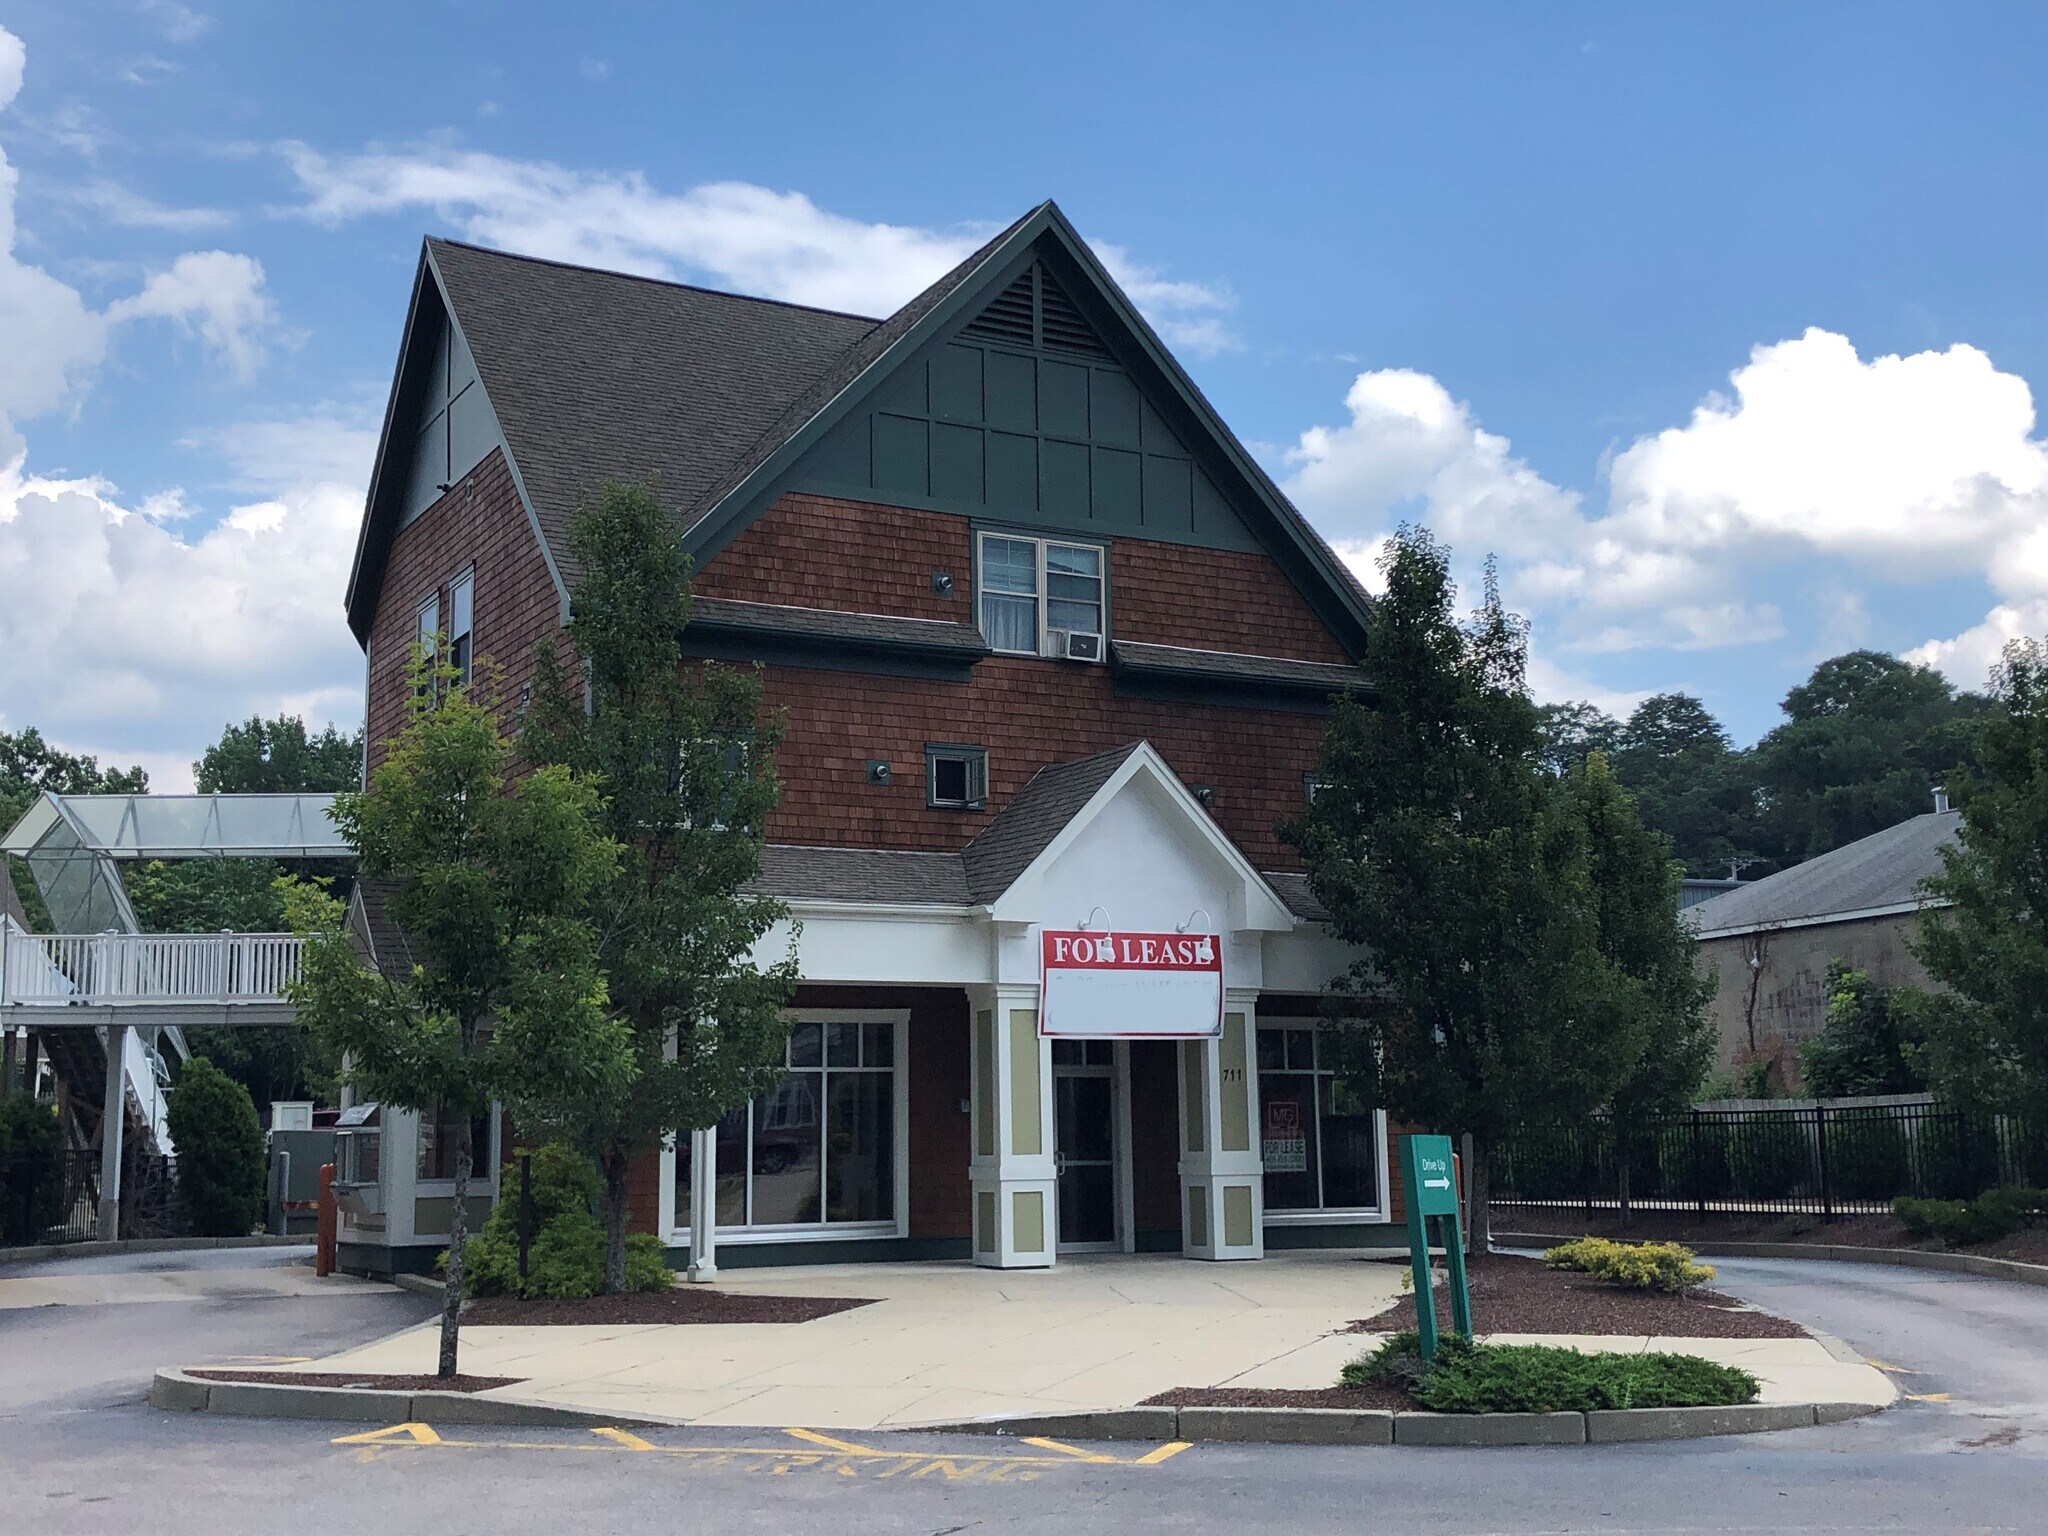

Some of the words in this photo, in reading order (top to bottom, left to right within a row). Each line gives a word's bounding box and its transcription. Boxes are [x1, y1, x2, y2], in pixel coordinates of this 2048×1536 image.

[1223, 1069, 1241, 1081] 711
[1265, 1141, 1279, 1154] FOR
[1281, 1141, 1305, 1154] LEASE
[1422, 1158, 1437, 1171] Drive
[1437, 1159, 1446, 1175] Up
[668, 1453, 1057, 1483] RKING
